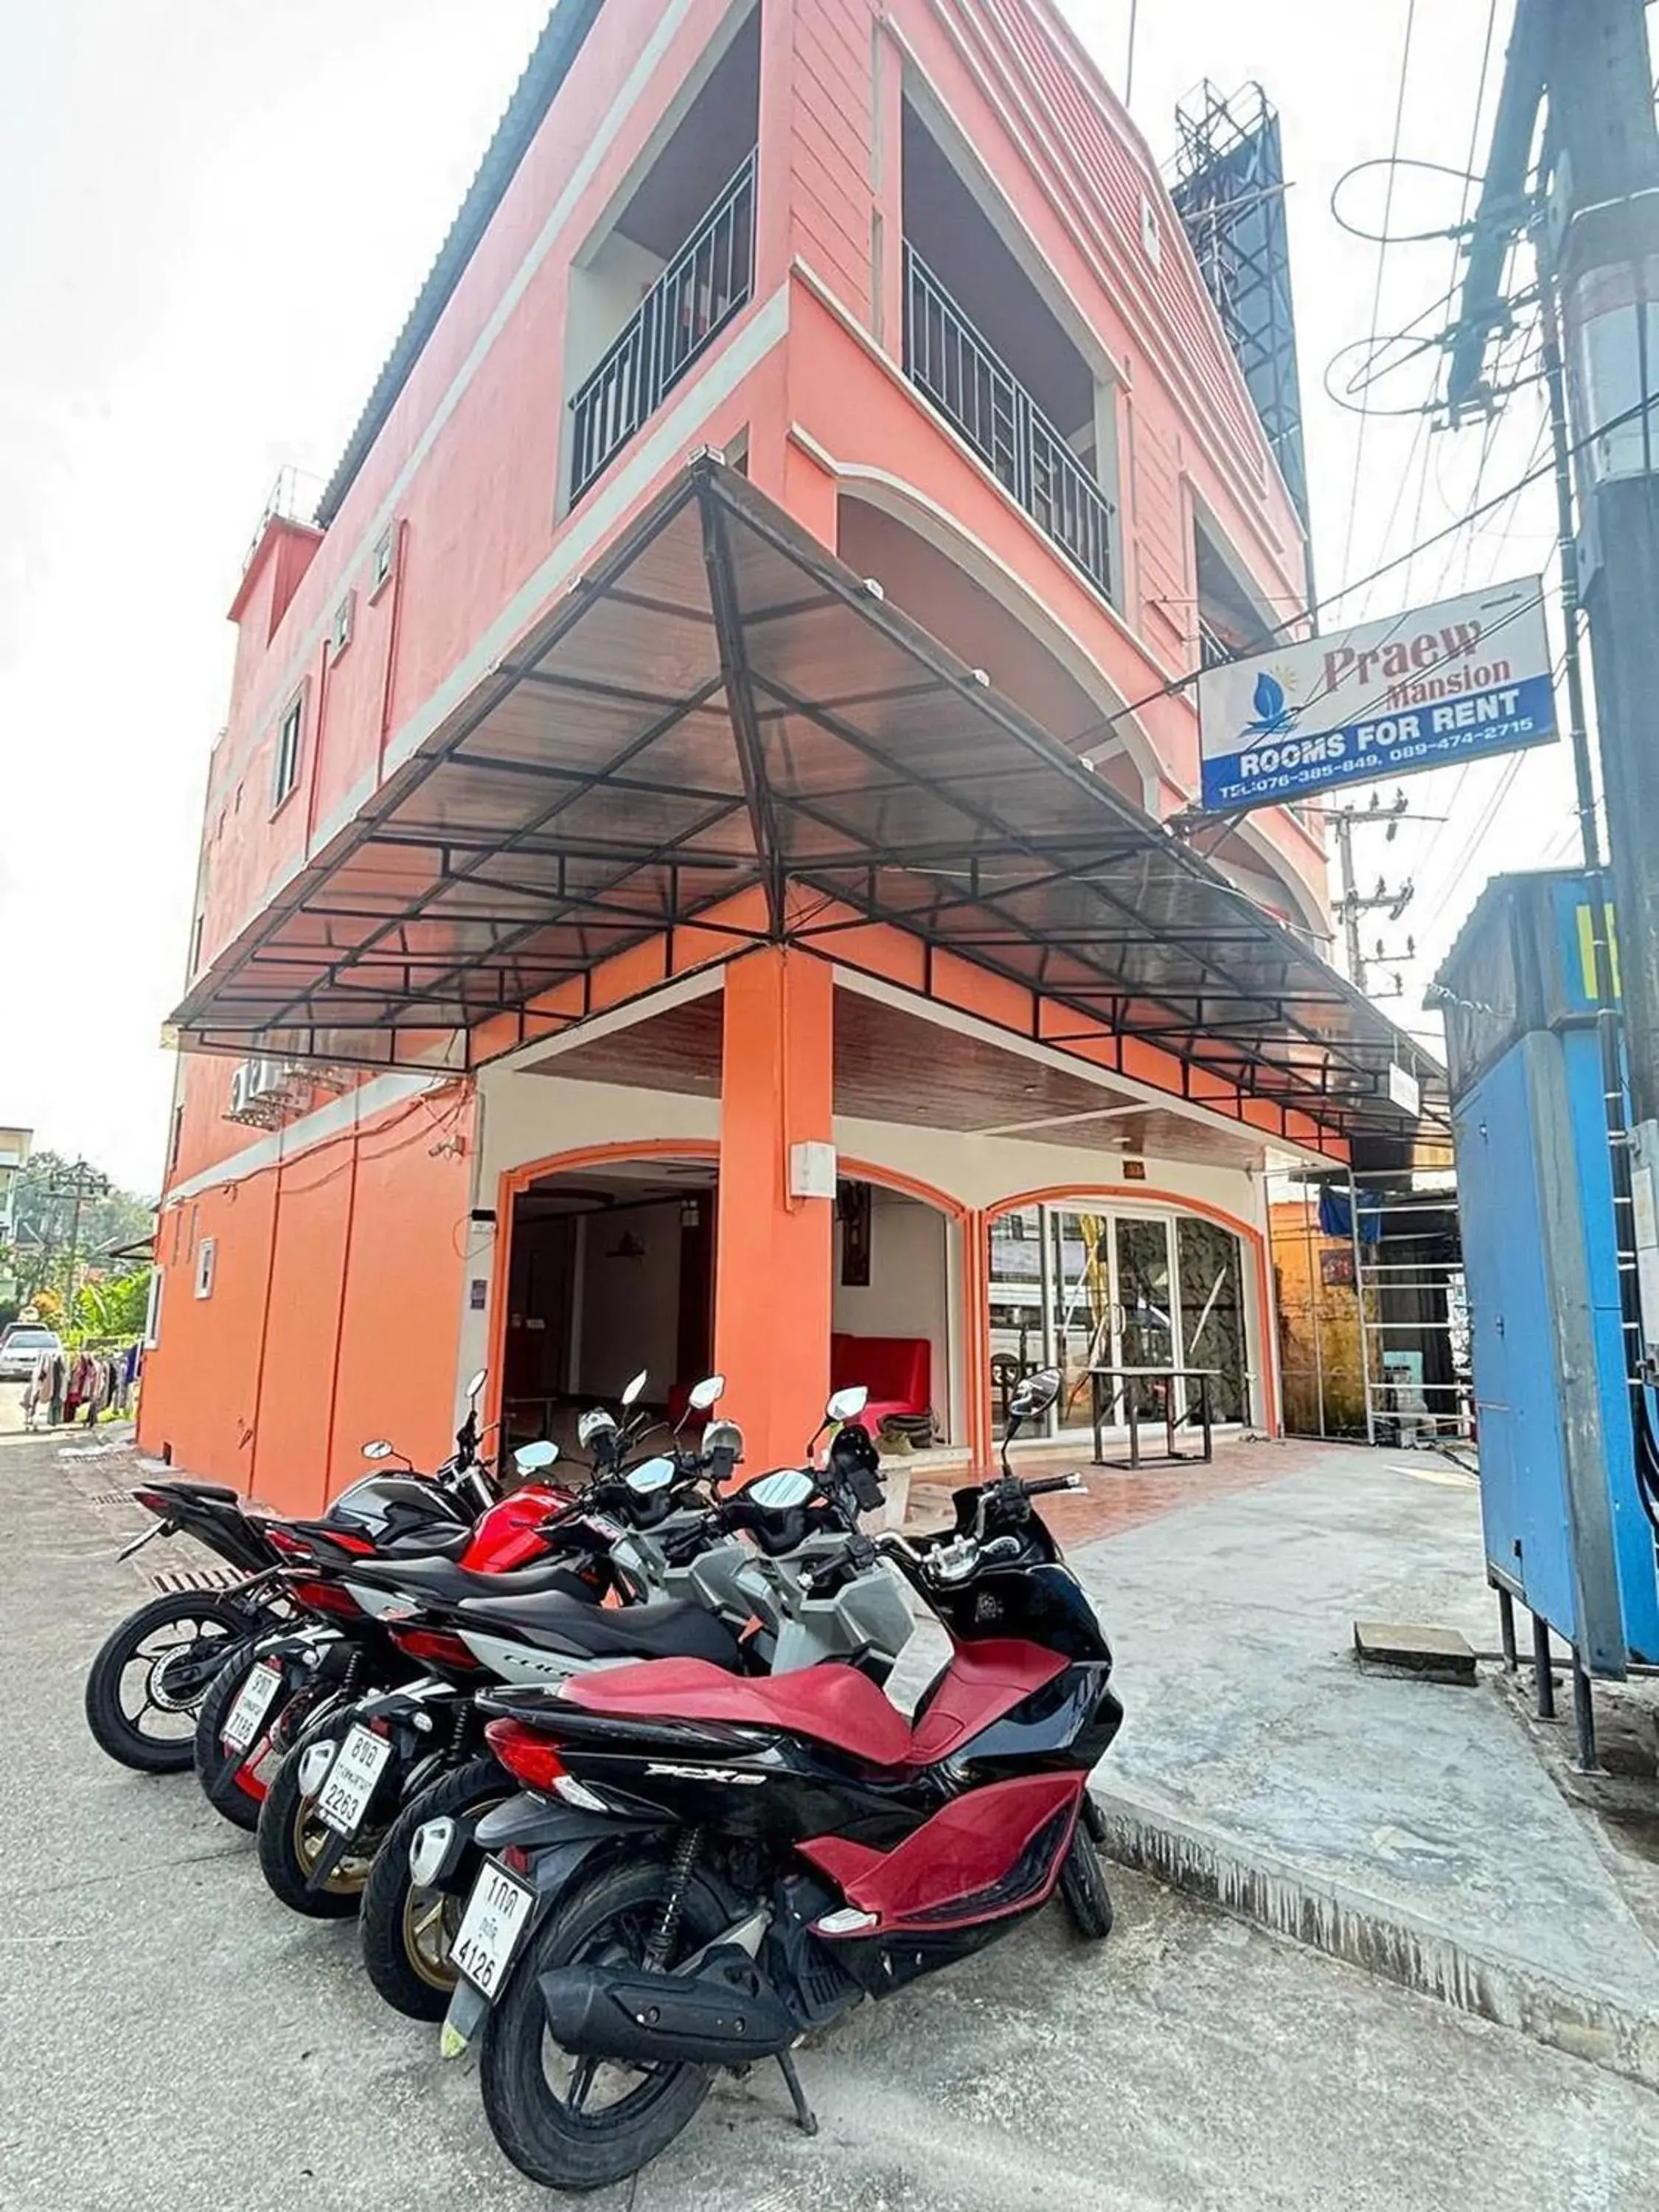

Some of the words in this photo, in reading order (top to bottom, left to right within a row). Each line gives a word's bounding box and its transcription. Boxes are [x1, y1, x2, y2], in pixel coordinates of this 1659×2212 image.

[1323, 619, 1482, 693] Praew
[1385, 660, 1511, 711] Mansion
[1239, 732, 1346, 779] ROOMS
[1357, 715, 1421, 751] FOR
[1431, 689, 1520, 734] RENT
[324, 1783, 360, 1821] 2263
[458, 1938, 496, 1989] 4126
